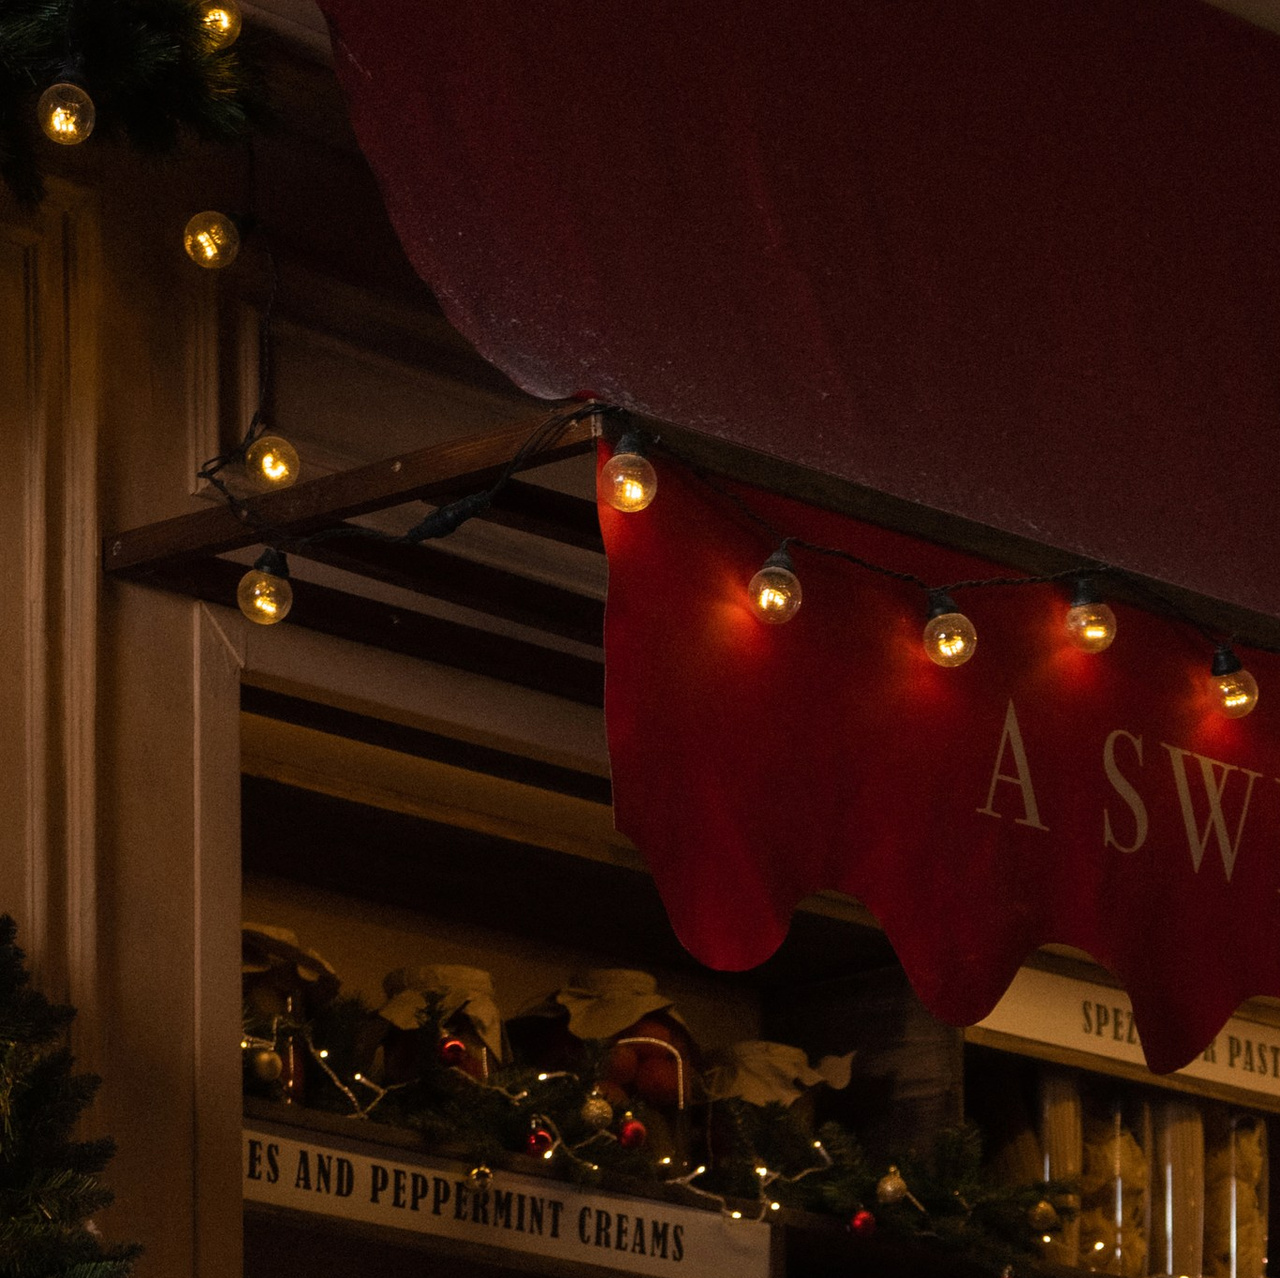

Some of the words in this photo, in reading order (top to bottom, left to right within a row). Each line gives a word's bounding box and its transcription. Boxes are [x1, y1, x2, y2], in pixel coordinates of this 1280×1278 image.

[974, 698, 1051, 832] A
[294, 1150, 355, 1199] AND
[370, 1163, 565, 1241] PEPPERMINT
[577, 1205, 686, 1263] CREAMS
